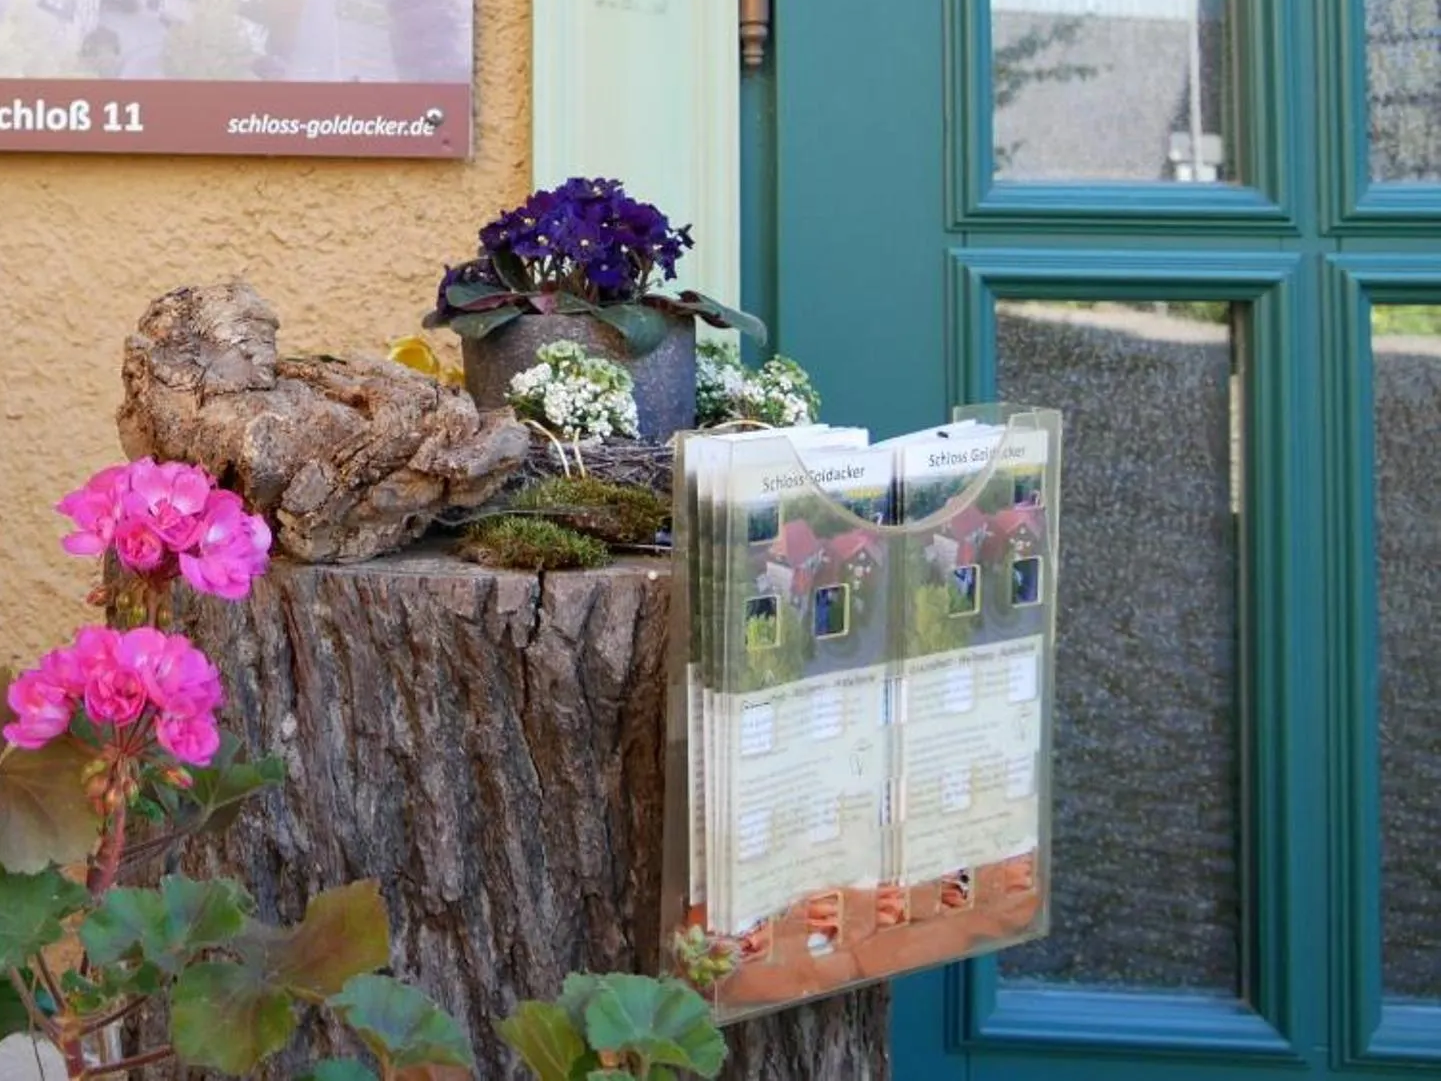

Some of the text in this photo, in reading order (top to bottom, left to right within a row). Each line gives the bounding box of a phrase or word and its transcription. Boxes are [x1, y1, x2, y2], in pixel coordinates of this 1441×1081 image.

[103, 101, 144, 132] 11
[227, 114, 436, 139] schloss-goldacker.de
[928, 449, 968, 468] Schloss
